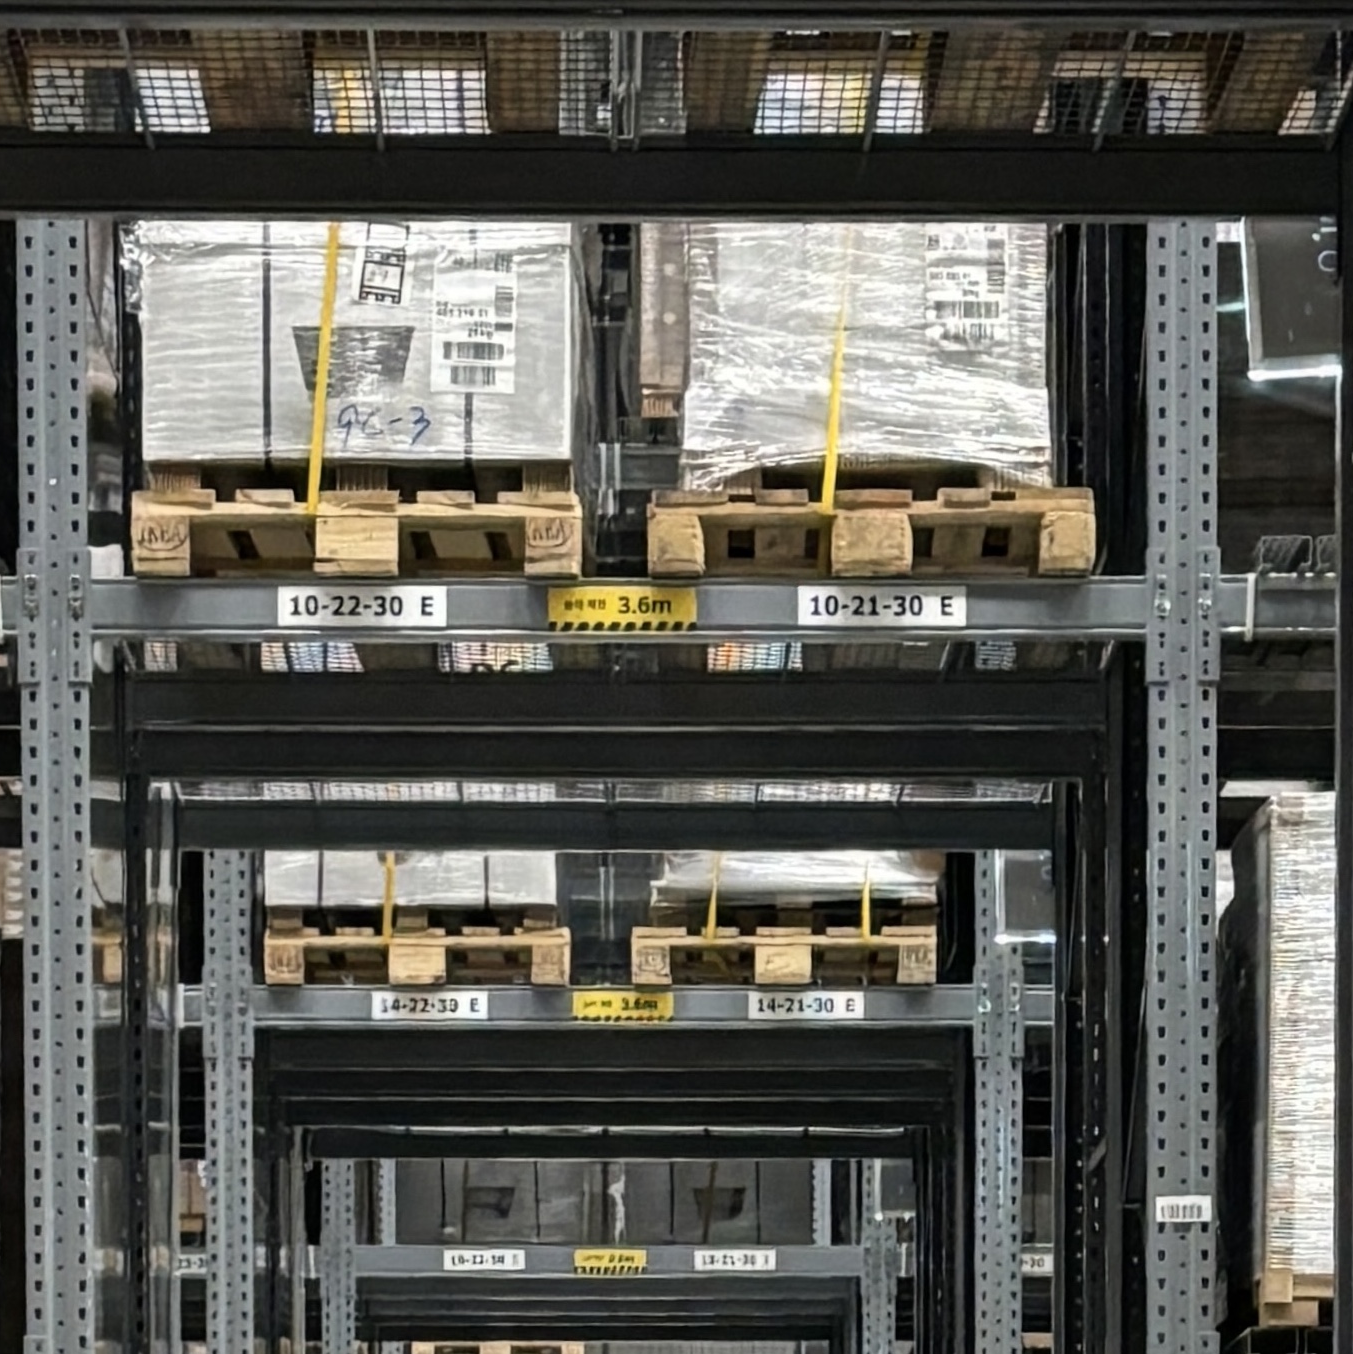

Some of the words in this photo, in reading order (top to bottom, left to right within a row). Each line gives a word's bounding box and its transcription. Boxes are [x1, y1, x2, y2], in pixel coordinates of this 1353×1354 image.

[289, 595, 404, 617] 10-22-30
[420, 596, 434, 616] E
[618, 596, 672, 614] 3.6m
[810, 595, 924, 616] 10-21-30
[940, 596, 954, 616] E
[757, 998, 835, 1012] 14-21-30
